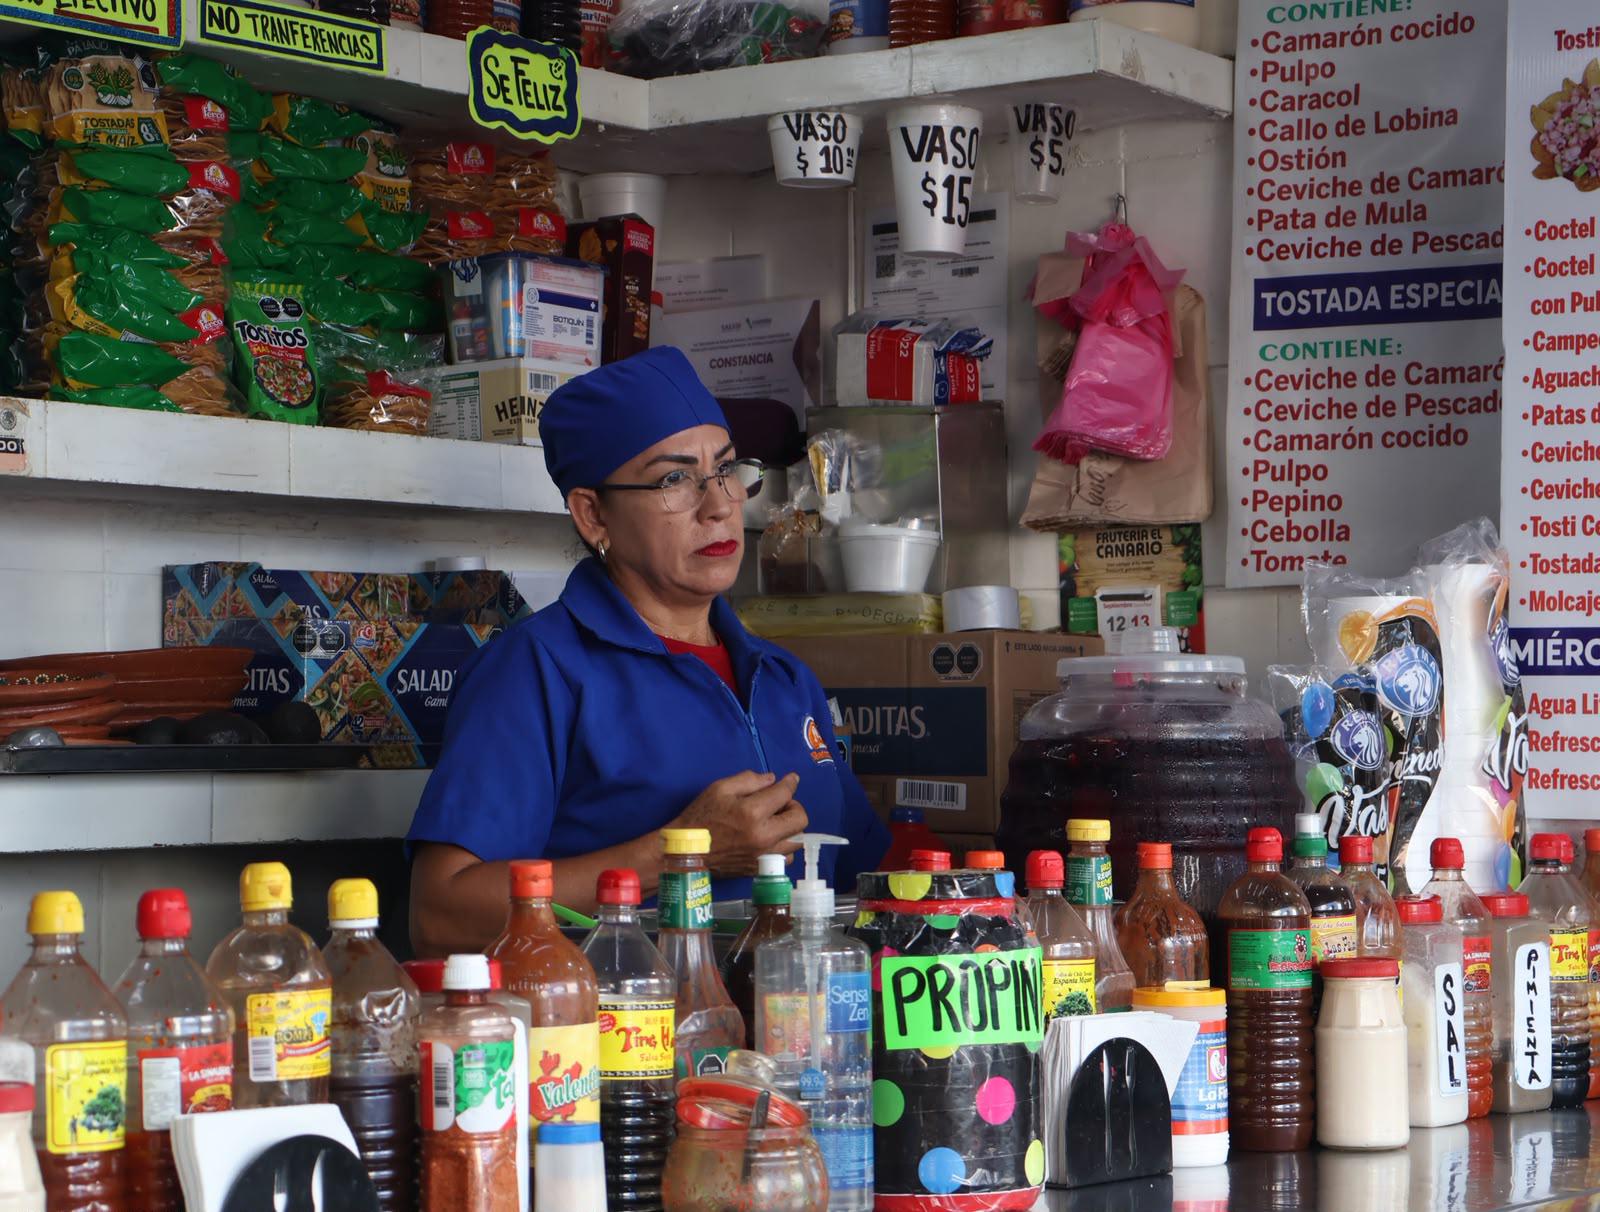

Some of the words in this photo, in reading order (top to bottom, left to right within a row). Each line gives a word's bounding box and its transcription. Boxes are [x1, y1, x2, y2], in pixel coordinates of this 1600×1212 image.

[1266, 0, 1413, 24] CONTIENE:
[207, 5, 241, 35] NO
[244, 12, 375, 61] TRANFERENCIAS
[1261, 25, 1382, 54] Camarón
[1390, 11, 1475, 42] cocido
[1554, 27, 1600, 51] Tosti
[1260, 59, 1336, 86] Pulpo
[1259, 83, 1361, 112] Caracol
[82, 117, 135, 128] TOSTADAS
[783, 113, 848, 145] VASO
[1013, 103, 1076, 140] VASO
[1258, 117, 1328, 142] Callo
[1335, 112, 1366, 137] de
[1374, 104, 1459, 134] Lobina
[900, 125, 980, 170] VASO
[1258, 146, 1347, 172] Ostión
[1257, 175, 1363, 202] Ceviche
[1370, 171, 1400, 195] de
[1257, 208, 1316, 232] Pata
[1324, 204, 1357, 230] de
[1365, 199, 1427, 226] Mula
[1534, 216, 1596, 242] Coctel
[1256, 235, 1362, 262] Ceviche
[1370, 231, 1403, 256] de
[1533, 253, 1595, 279] Coctel
[1261, 285, 1382, 318] TOSTADA
[1390, 278, 1502, 310] ESPECIA
[1530, 298, 1565, 316] con
[1258, 338, 1403, 362] CONTIENE:
[1532, 330, 1600, 355] Campe
[709, 352, 774, 370] CONSTANCIA
[1255, 364, 1357, 393] Ceviche
[1364, 363, 1396, 389] de
[1254, 397, 1357, 423] Ceviche
[1365, 394, 1397, 419] de
[1404, 389, 1503, 417] Pescad
[1532, 404, 1586, 426] Patas
[1254, 425, 1373, 453] Camarón
[1381, 423, 1469, 450] cocido
[1253, 459, 1329, 487] Pulpo
[1252, 489, 1343, 517] Pepino
[1096, 529, 1148, 544] FRUTERIA
[1151, 528, 1163, 540] EL
[1251, 519, 1351, 544] Cebolla
[1530, 515, 1576, 538] Tosti
[1096, 541, 1163, 559] CANARIO
[1106, 615, 1126, 632] 12
[397, 668, 457, 694] SALAD
[1528, 693, 1577, 720] Agua
[1582, 692, 1600, 715] Li
[1528, 730, 1600, 753] Refresc
[1528, 767, 1600, 790] Refresc
[831, 985, 868, 1004] Sensa
[890, 959, 1043, 1037] PROPIN
[848, 1003, 868, 1022] Zen
[1442, 973, 1461, 1083] SAL
